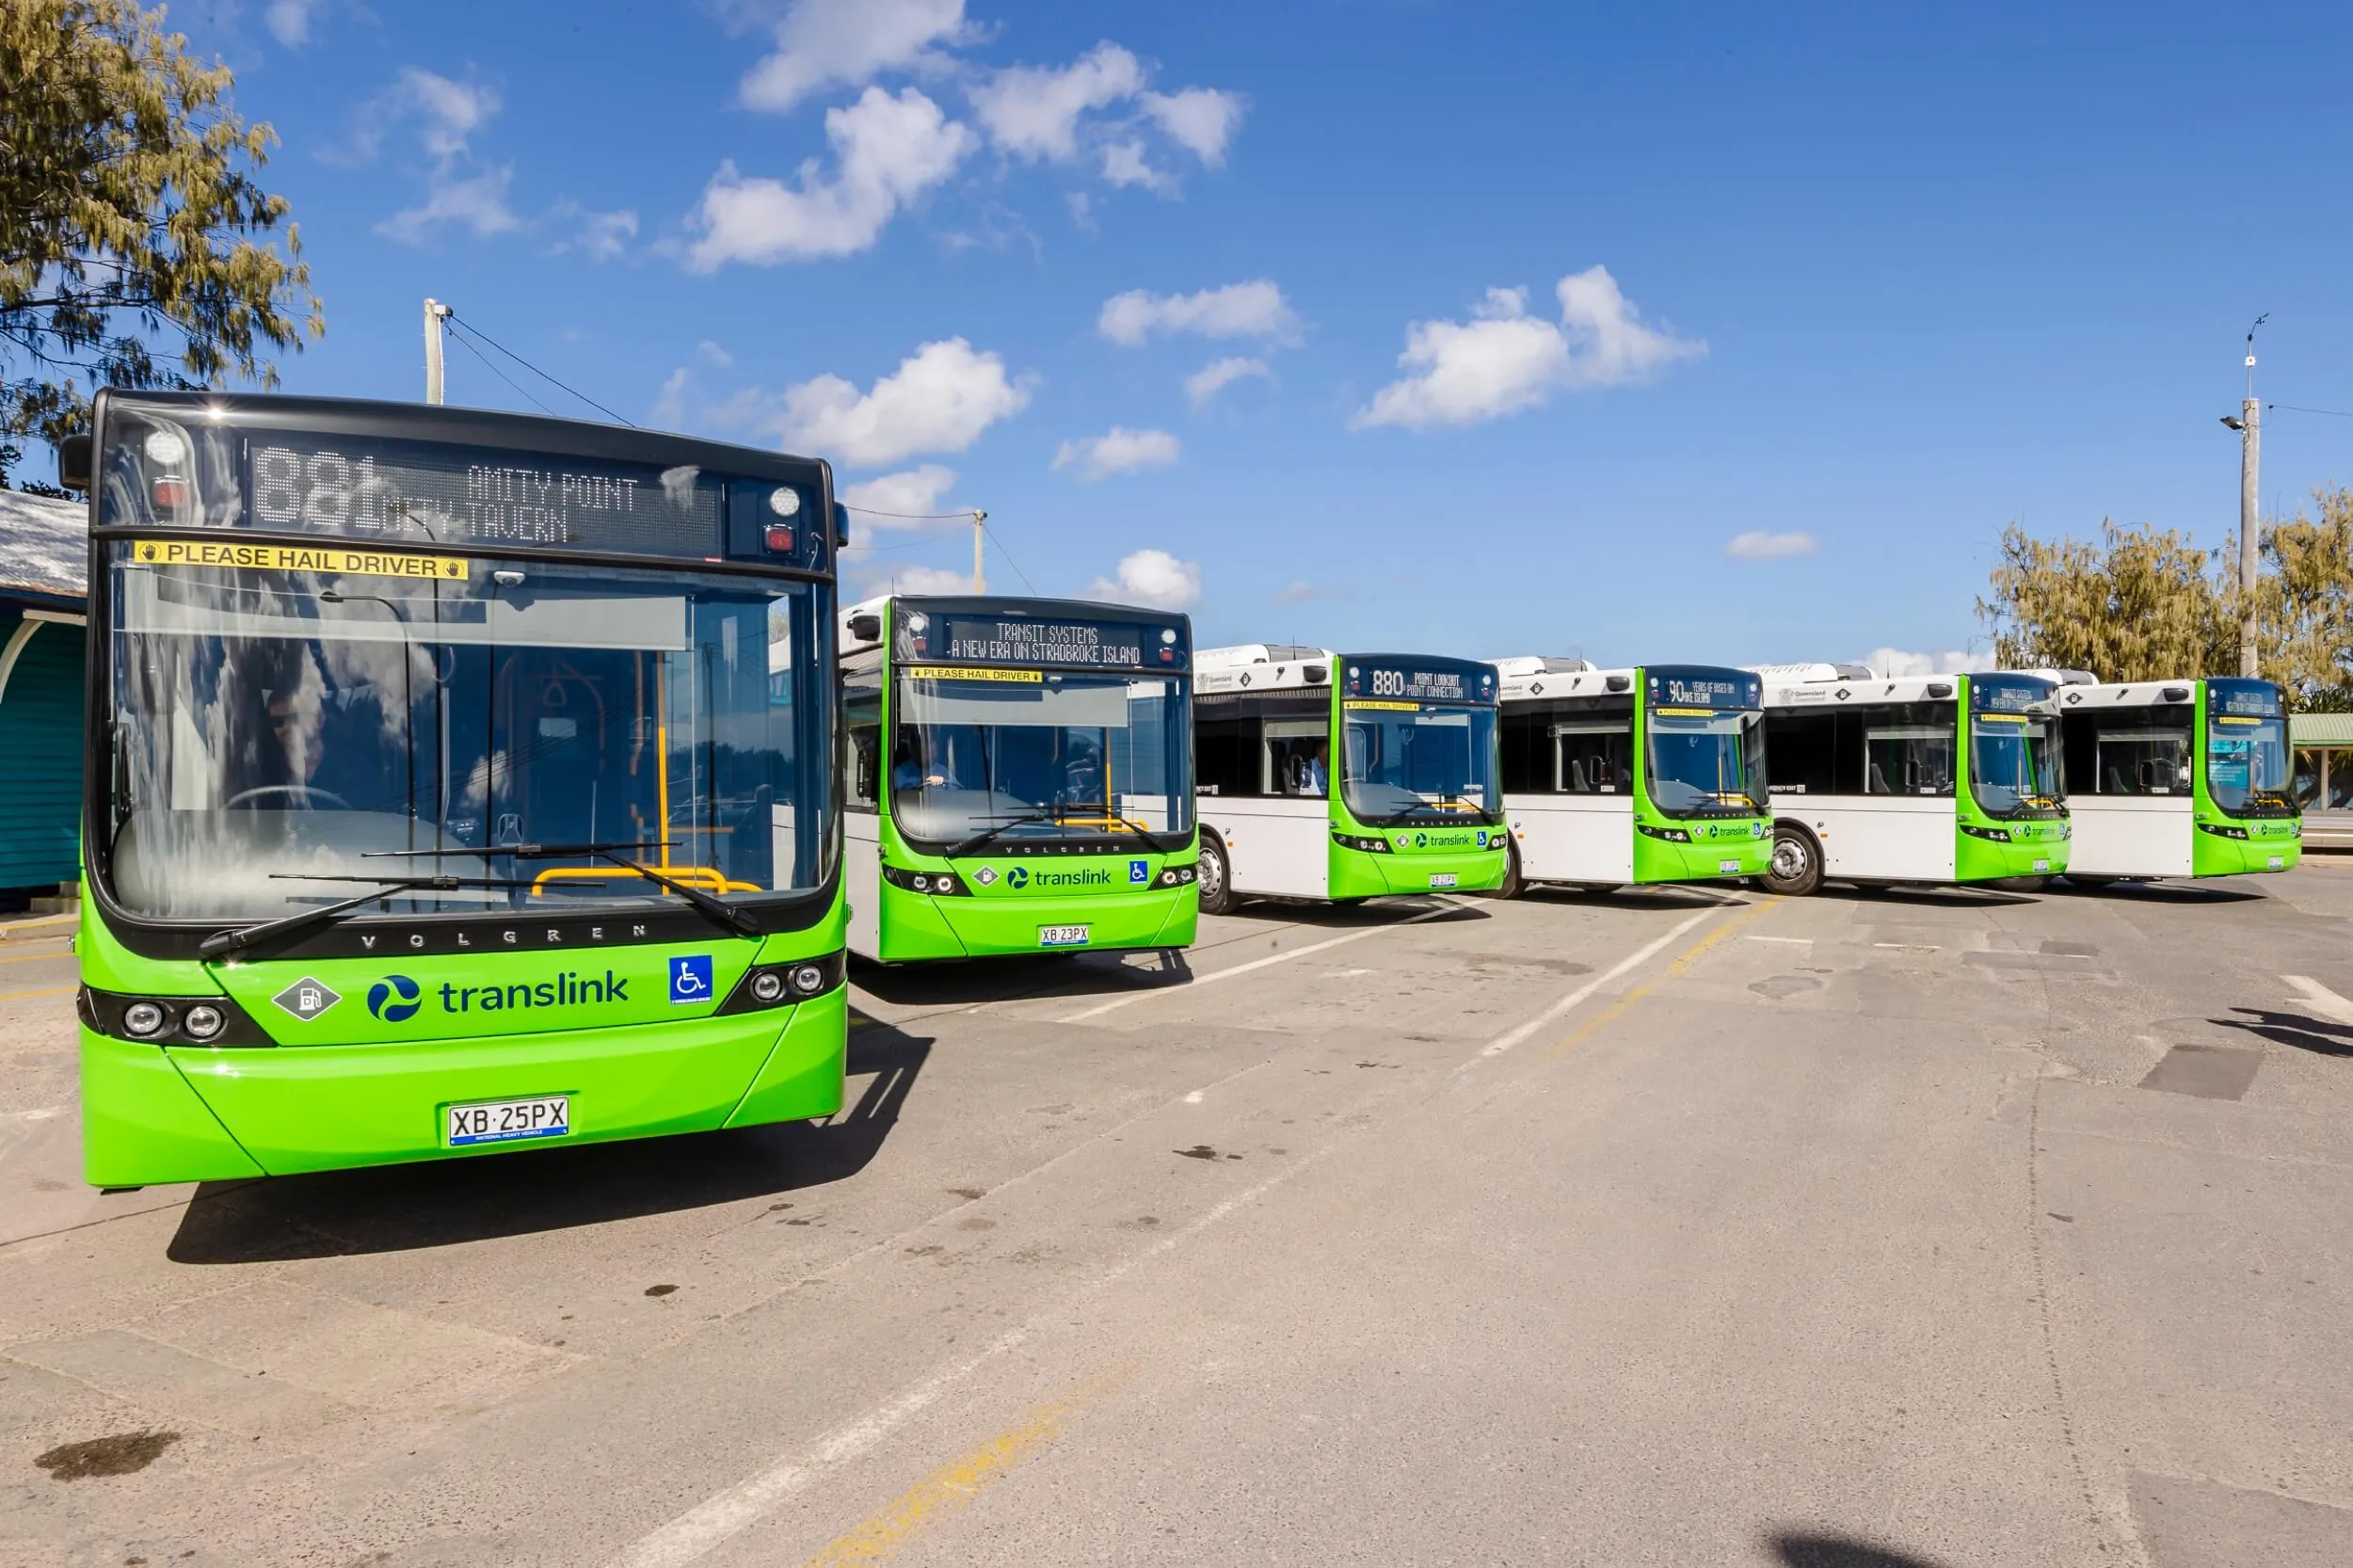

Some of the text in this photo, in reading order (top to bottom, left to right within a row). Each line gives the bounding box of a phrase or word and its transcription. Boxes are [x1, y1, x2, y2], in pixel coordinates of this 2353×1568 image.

[257, 446, 380, 529] 881
[469, 465, 638, 511] AMITY POINT
[466, 502, 567, 543] TAVERN
[168, 544, 439, 576] PLEASE HAIL DRIVER
[996, 622, 1098, 645] TRANSIT SYSTEMS
[952, 639, 1140, 664] A NEW ERA ON STRADBROKE ISLAND
[923, 668, 1031, 681] PLEASE HAIL DRIVER
[1373, 670, 1404, 696] 880
[1414, 672, 1460, 687] POINT LOOKOUT
[1406, 684, 1463, 698] POINT CONNECTION
[1669, 680, 1685, 702] 90
[1431, 834, 1470, 846] translink
[1035, 868, 1112, 886] translink
[361, 923, 648, 949] VOLGREN
[438, 970, 629, 1013] translink
